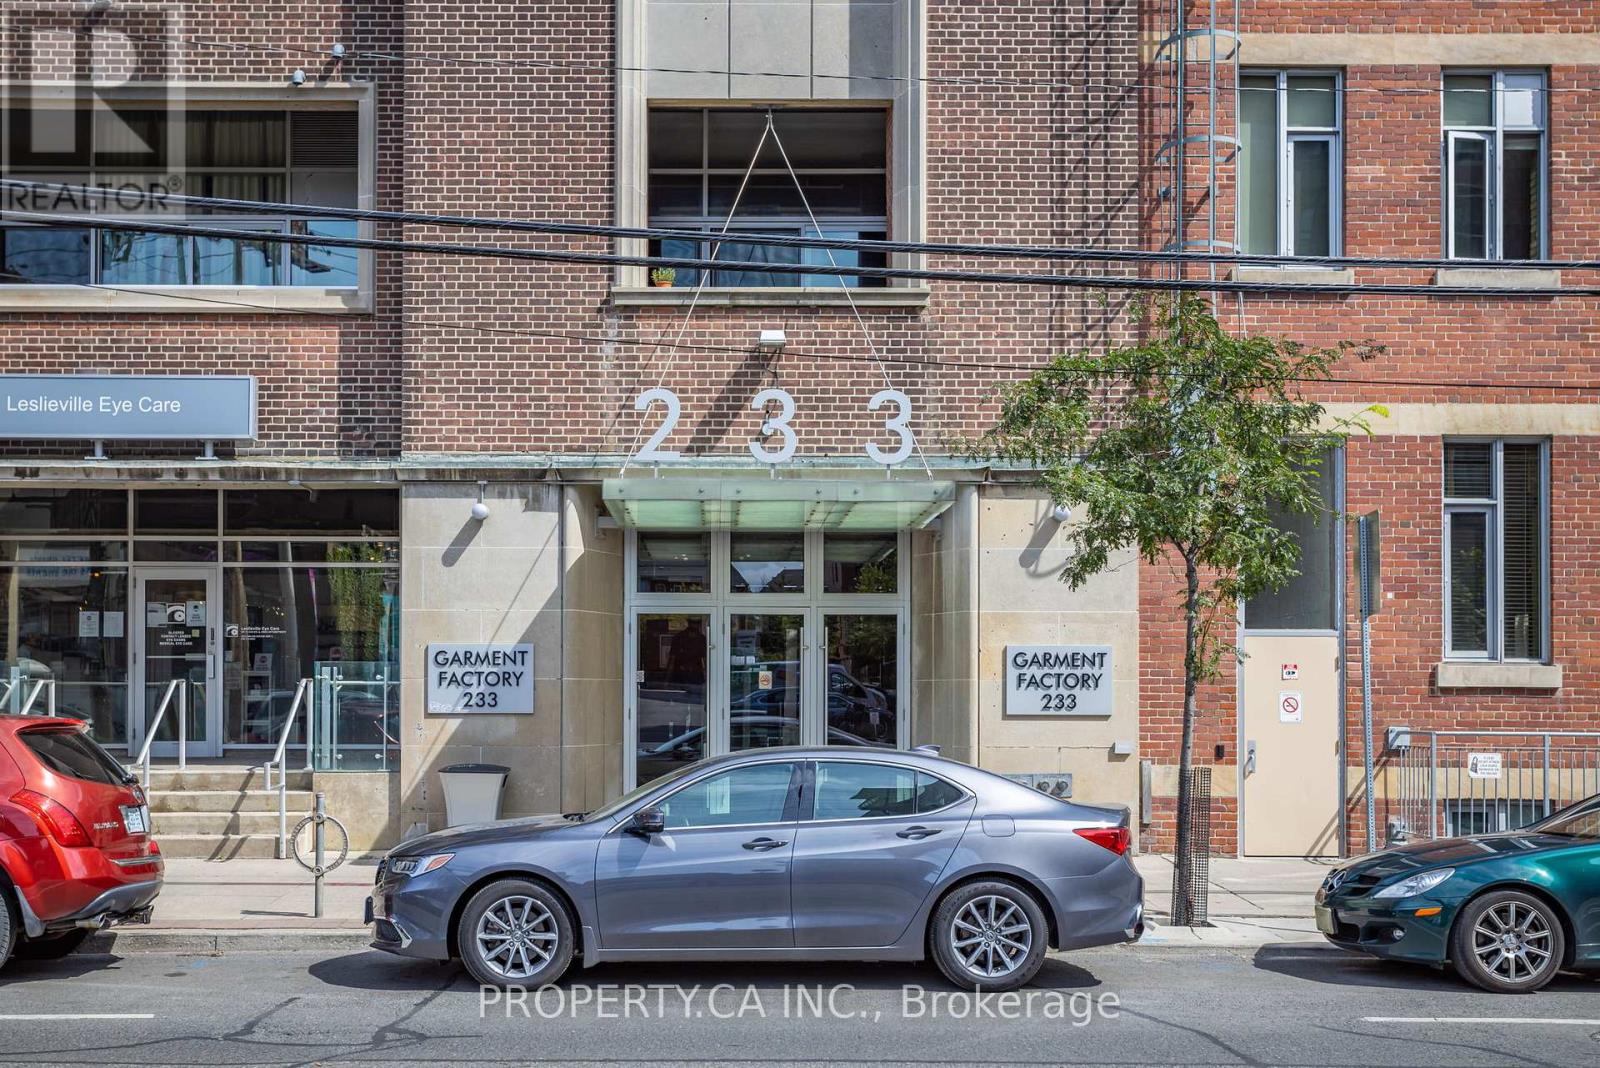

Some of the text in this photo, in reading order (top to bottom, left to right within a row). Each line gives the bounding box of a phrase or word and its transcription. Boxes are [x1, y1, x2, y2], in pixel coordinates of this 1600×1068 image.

[7, 395, 181, 416] Leslieville Eye Care
[434, 650, 528, 667] GARMENT
[1013, 651, 1107, 668] GARMENT
[438, 671, 524, 688] FACTORY
[1017, 672, 1103, 689] FACTORY
[463, 692, 498, 708] 233
[1041, 693, 1077, 710] 233
